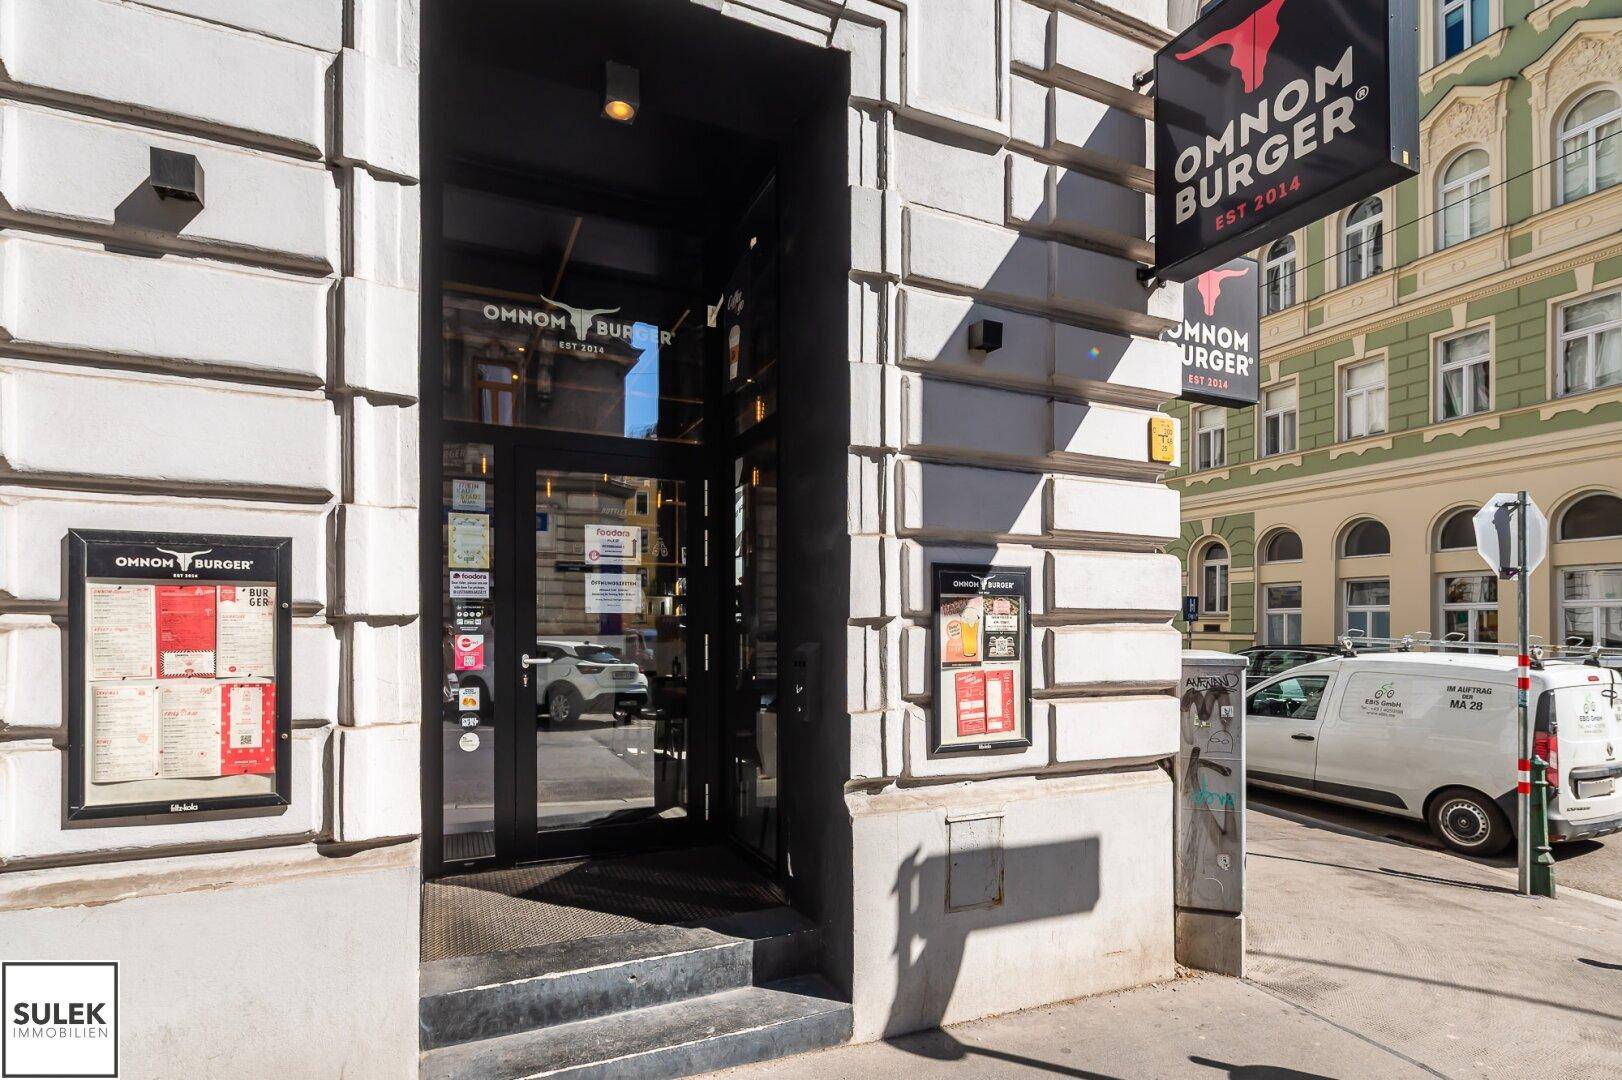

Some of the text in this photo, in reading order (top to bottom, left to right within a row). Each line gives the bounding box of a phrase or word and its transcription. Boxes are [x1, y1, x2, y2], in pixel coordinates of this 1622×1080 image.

[1174, 46, 1352, 183] OMNOM
[1215, 175, 1301, 230] EST 2014
[484, 304, 566, 329] OMNOM
[559, 341, 604, 354] EST 2014
[1188, 374, 1228, 389] EST 2014
[596, 528, 630, 537] foodora
[115, 556, 174, 568] OMNOM
[249, 588, 269, 597] BUR
[249, 598, 269, 606] GER
[1457, 686, 1492, 695] AUFTRAG
[1450, 700, 1483, 710] MA 28
